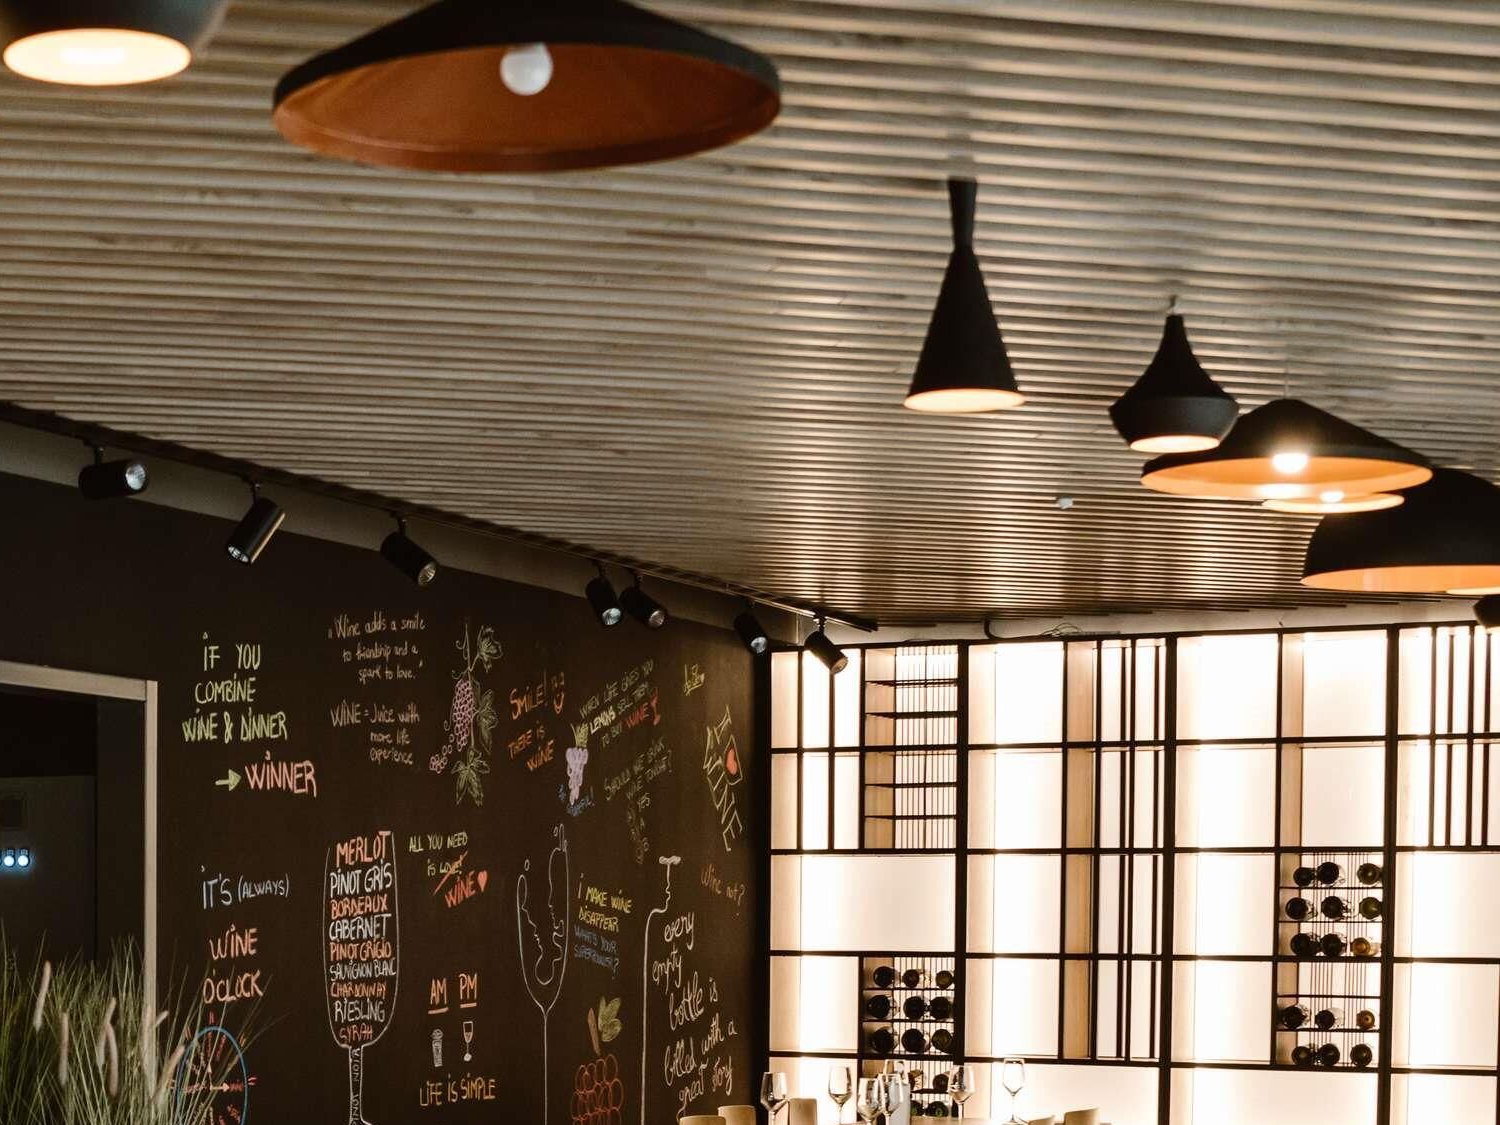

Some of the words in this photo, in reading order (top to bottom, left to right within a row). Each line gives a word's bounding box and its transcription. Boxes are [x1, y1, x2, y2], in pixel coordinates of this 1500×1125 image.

[391, 620, 397, 631] a
[202, 632, 221, 671] IF
[235, 643, 261, 671] YOU
[195, 673, 257, 704] COMBINE
[182, 708, 219, 743] WINE
[223, 712, 234, 744] &
[240, 707, 289, 743] DINNER
[330, 699, 362, 728] WINE
[398, 702, 420, 724] with
[370, 731, 392, 744] more
[245, 750, 317, 798] WINNER
[336, 830, 392, 868] MERLOT
[408, 834, 424, 853] ALL
[426, 833, 444, 851] YOU
[446, 830, 468, 849] NEED
[202, 865, 233, 910] IT'S
[237, 872, 291, 903] (ALWAYS)
[329, 868, 363, 899] PINOT
[364, 858, 393, 893] GRIS
[444, 870, 477, 909] WINE
[330, 893, 389, 920] BORDEAUX
[208, 923, 258, 961] WINE
[329, 913, 392, 940] CABERNET
[663, 911, 695, 951] every
[329, 941, 360, 962] PINOT
[329, 959, 374, 982] SAUVIGNON
[374, 956, 397, 977] BLANC
[652, 943, 682, 995] empty
[202, 967, 265, 1005] O'CLOCK
[429, 976, 448, 1006] AM
[458, 971, 478, 1001] PM
[668, 970, 705, 1031] bottle
[708, 977, 718, 1003] is
[334, 997, 386, 1023] RIESLING
[339, 1022, 373, 1042] SYRAH
[701, 1012, 726, 1055] with
[728, 1019, 739, 1036] a
[419, 1080, 443, 1107] LIFE
[447, 1072, 458, 1103] IS
[460, 1072, 496, 1101] SIMPLE
